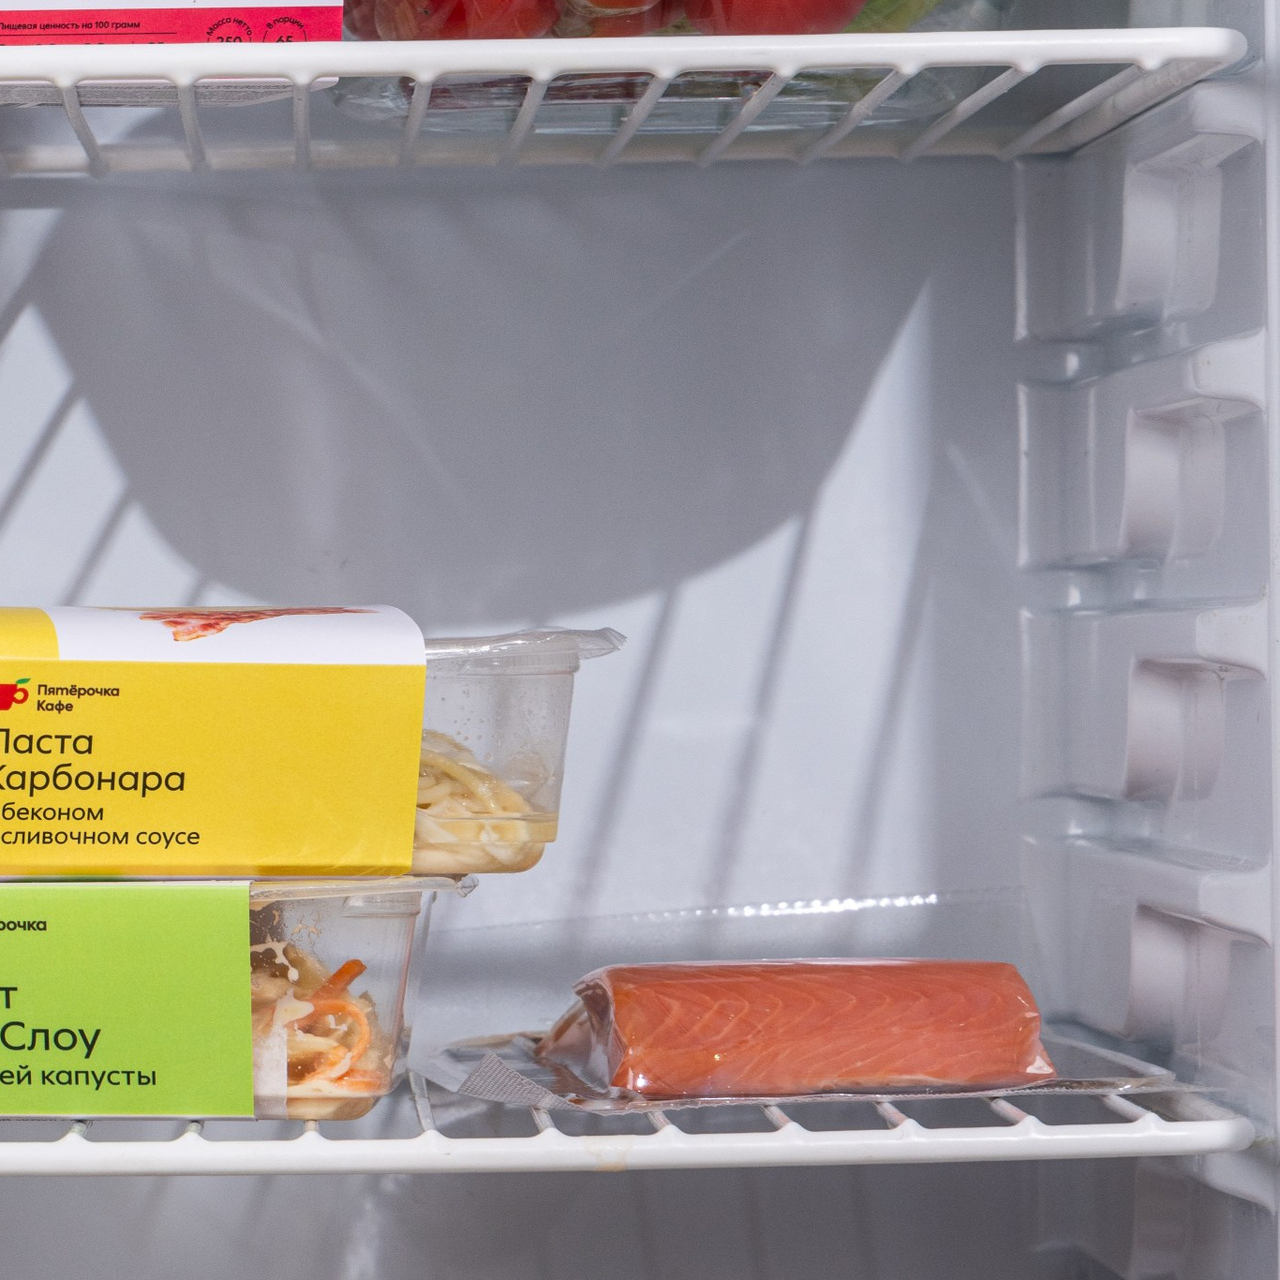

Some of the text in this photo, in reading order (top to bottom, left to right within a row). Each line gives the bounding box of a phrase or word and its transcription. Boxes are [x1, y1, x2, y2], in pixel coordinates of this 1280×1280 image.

[39, 22, 79, 30] ценность
[111, 22, 140, 30] грамм
[206, 17, 252, 36] Масса нетто
[272, 16, 304, 29] порции
[37, 684, 120, 698] Пятёрочка
[36, 700, 74, 714] Кафе
[1, 801, 104, 822] беконом
[0, 830, 129, 846] сливочном
[136, 830, 200, 849] соусе
[0, 1021, 101, 1058] Слоу
[41, 1068, 157, 1090] капусты
